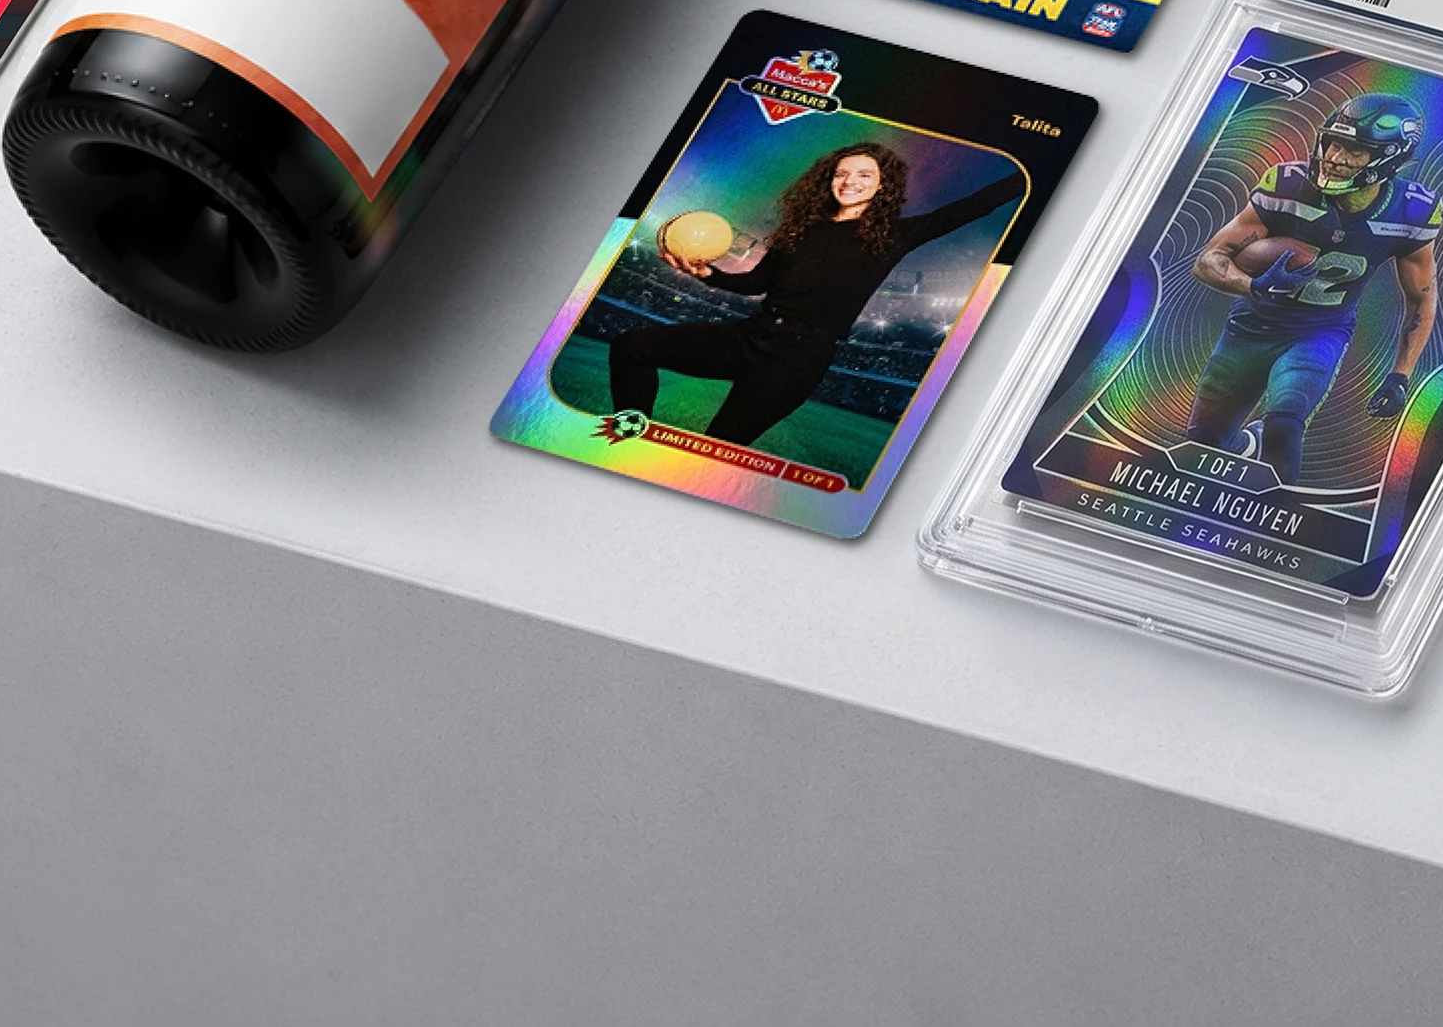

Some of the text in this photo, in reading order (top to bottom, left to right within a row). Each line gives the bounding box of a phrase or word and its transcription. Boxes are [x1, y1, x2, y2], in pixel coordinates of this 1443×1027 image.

[751, 82, 829, 108] ALL STARS
[1011, 114, 1061, 137] Talita
[1298, 251, 1368, 306] 2
[652, 429, 777, 472] LIMITED EDITION
[1197, 453, 1249, 482] 1 OF 1
[1109, 461, 1304, 537] MICHAEL NGUYEN
[1077, 493, 1301, 570] SEATTLE SEAHAWKS
